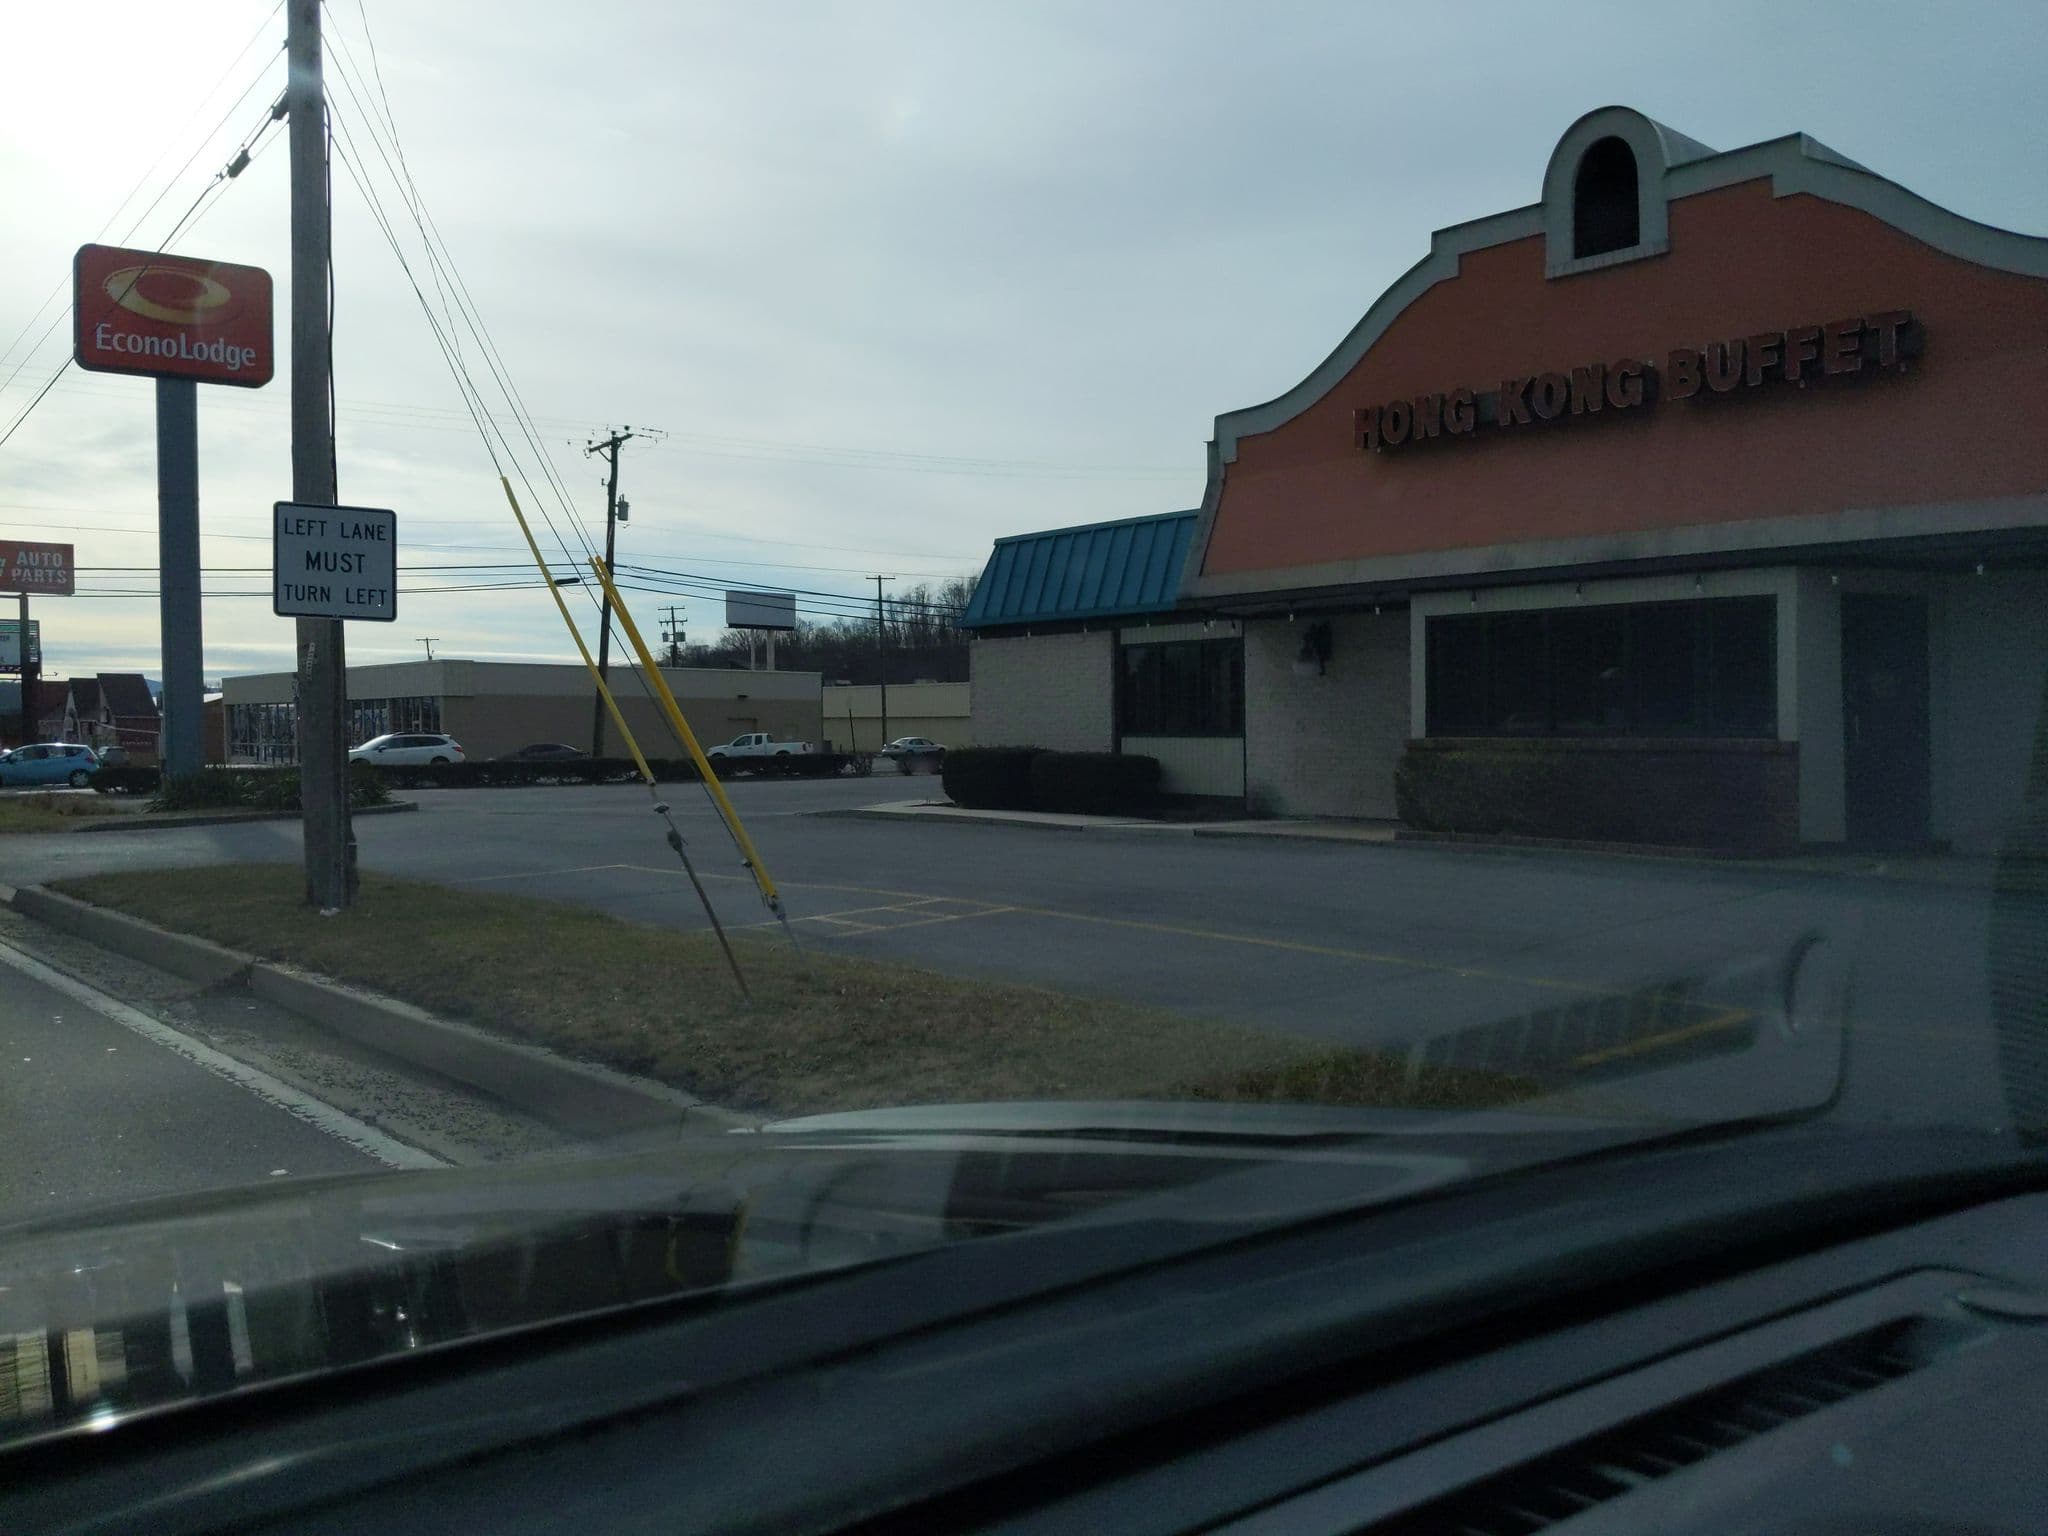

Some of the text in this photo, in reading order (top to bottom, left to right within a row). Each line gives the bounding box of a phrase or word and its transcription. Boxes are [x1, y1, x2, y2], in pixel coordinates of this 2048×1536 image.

[96, 322, 256, 371] EconoLodge
[1353, 309, 1913, 450] HONG KONG BUFFET
[284, 518, 387, 541] LEFT LANE
[16, 551, 63, 567] AUTO
[305, 550, 366, 573] MUST
[11, 567, 67, 584] PARTS
[284, 584, 387, 605] TURN LEFT
